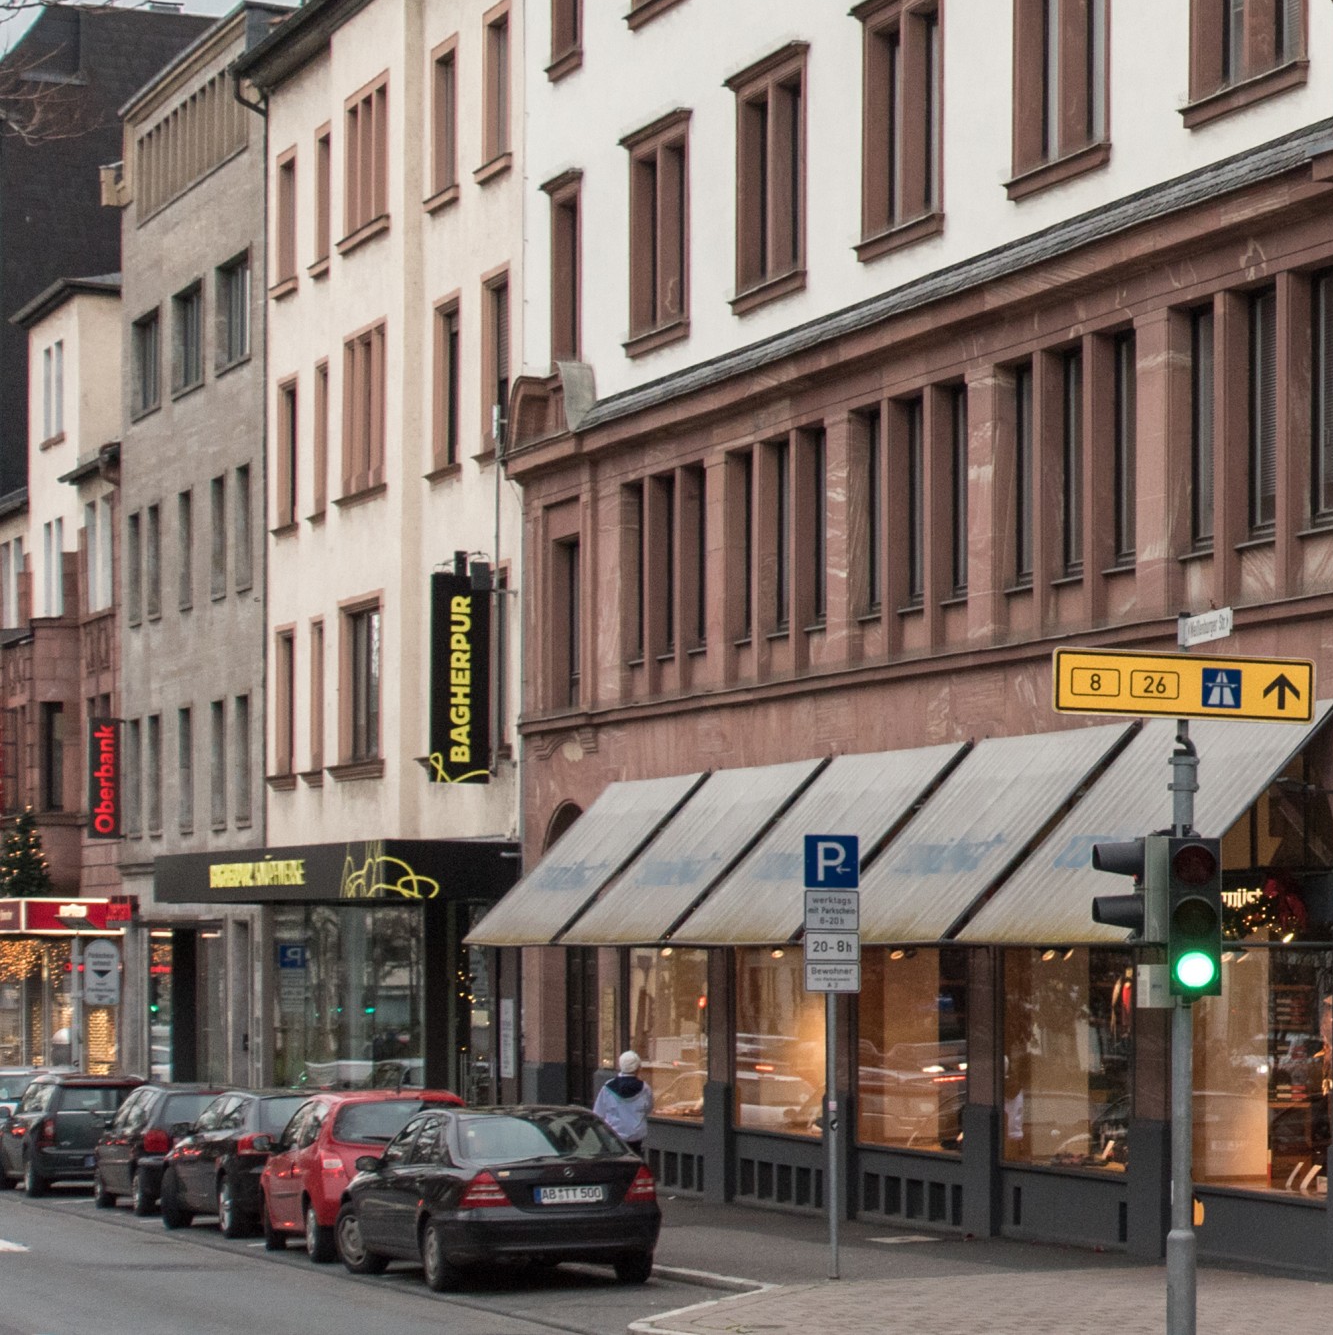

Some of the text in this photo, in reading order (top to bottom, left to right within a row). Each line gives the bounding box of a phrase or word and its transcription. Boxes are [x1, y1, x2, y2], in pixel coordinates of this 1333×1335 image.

[450, 595, 472, 763] BAGHERPUR
[1090, 673, 1166, 694] 8 26
[93, 724, 115, 834] Oberbank
[817, 841, 847, 882] P
[812, 896, 852, 907] werktags
[811, 967, 854, 976] Bewohner
[542, 1187, 602, 1200] AB TT 500
